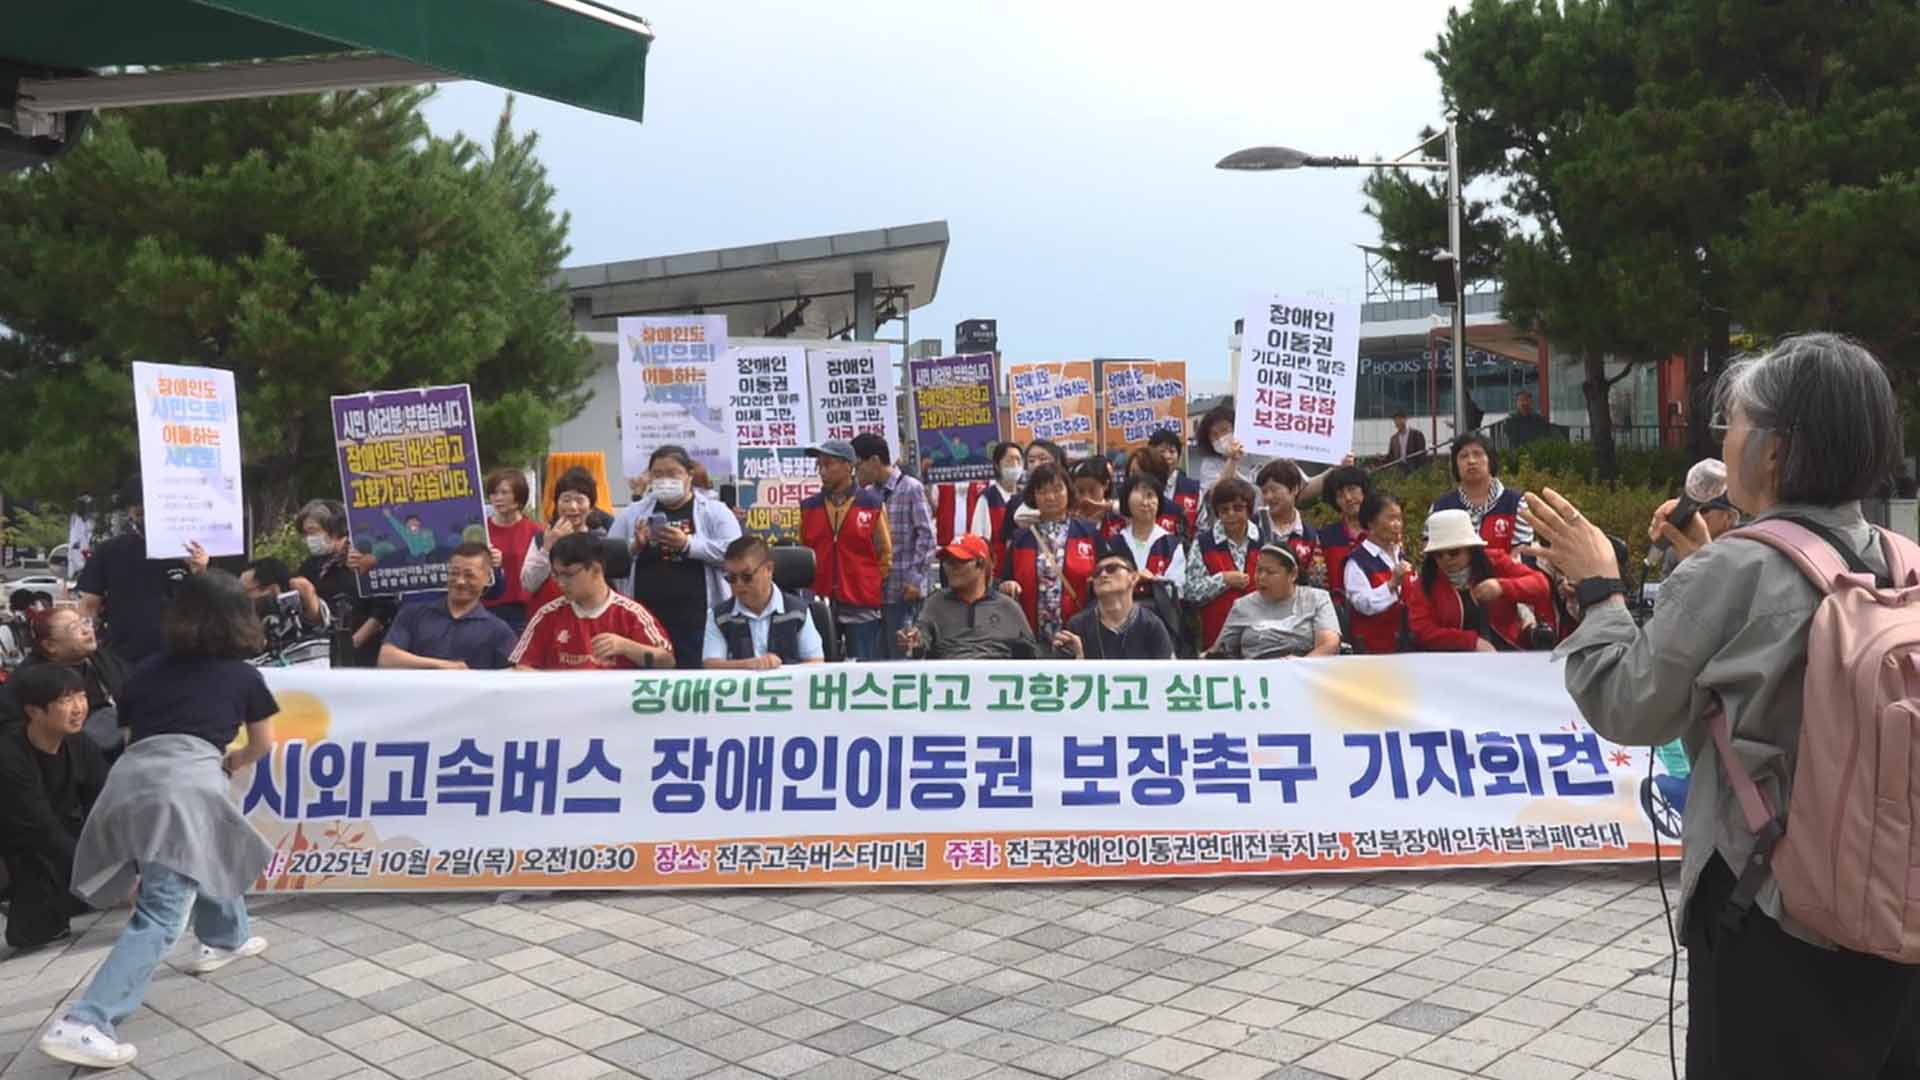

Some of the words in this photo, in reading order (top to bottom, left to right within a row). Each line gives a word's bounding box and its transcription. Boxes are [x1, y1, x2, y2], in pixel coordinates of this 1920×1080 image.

[1270, 304, 1334, 332] 장애인
[642, 326, 704, 343] 장애인도
[1267, 329, 1332, 357] 이동권
[736, 356, 787, 375] 장애인
[826, 357, 874, 377] 장애인
[1252, 349, 1312, 370] 기다리란
[1316, 358, 1346, 376] 말은
[158, 378, 217, 400] 장애인도
[738, 376, 788, 393] 이동권
[828, 377, 876, 395] 이동권
[1257, 368, 1292, 388] 이제
[1297, 374, 1336, 396] 그만,
[735, 408, 761, 422] 이제
[766, 408, 795, 421] 그만,
[826, 410, 851, 424] 이제
[855, 408, 885, 422] 그만,
[1256, 388, 1292, 409] 지금
[1299, 394, 1336, 416] 당장
[344, 410, 367, 440] 시민
[368, 405, 403, 437] 여러분
[404, 400, 467, 433] 부럽습니다.
[736, 425, 763, 439] 지금
[769, 423, 796, 437] 당장
[828, 425, 853, 439] 지금
[1253, 409, 1335, 438] 보장하라
[346, 441, 405, 473] 장애인도
[406, 434, 465, 468] 버스타고
[351, 476, 408, 508] 고향가고
[412, 469, 474, 503] 싶습니다.
[631, 676, 794, 715] 장애인도
[809, 673, 972, 712] 버스타고
[986, 673, 1149, 711] 고향가고
[1165, 672, 1270, 711] 싶다.!
[243, 738, 622, 819] 시외고속버스
[651, 735, 1033, 814] 장애인이동권
[1061, 732, 1317, 806] 보장촉구
[1344, 729, 1614, 799] 기자회견
[656, 845, 709, 873] 장소:
[716, 843, 926, 870] 전주고속버스터미널
[946, 841, 1000, 869] 주최:
[1007, 831, 1348, 866] 전국장애인이동권연대전북지부,
[1355, 822, 1626, 856] 전북장애인차별철폐연대
[289, 849, 373, 876] 2025년
[379, 849, 430, 875] 10월
[435, 847, 516, 875] 2일(목)
[521, 847, 636, 873] 오전10:30
